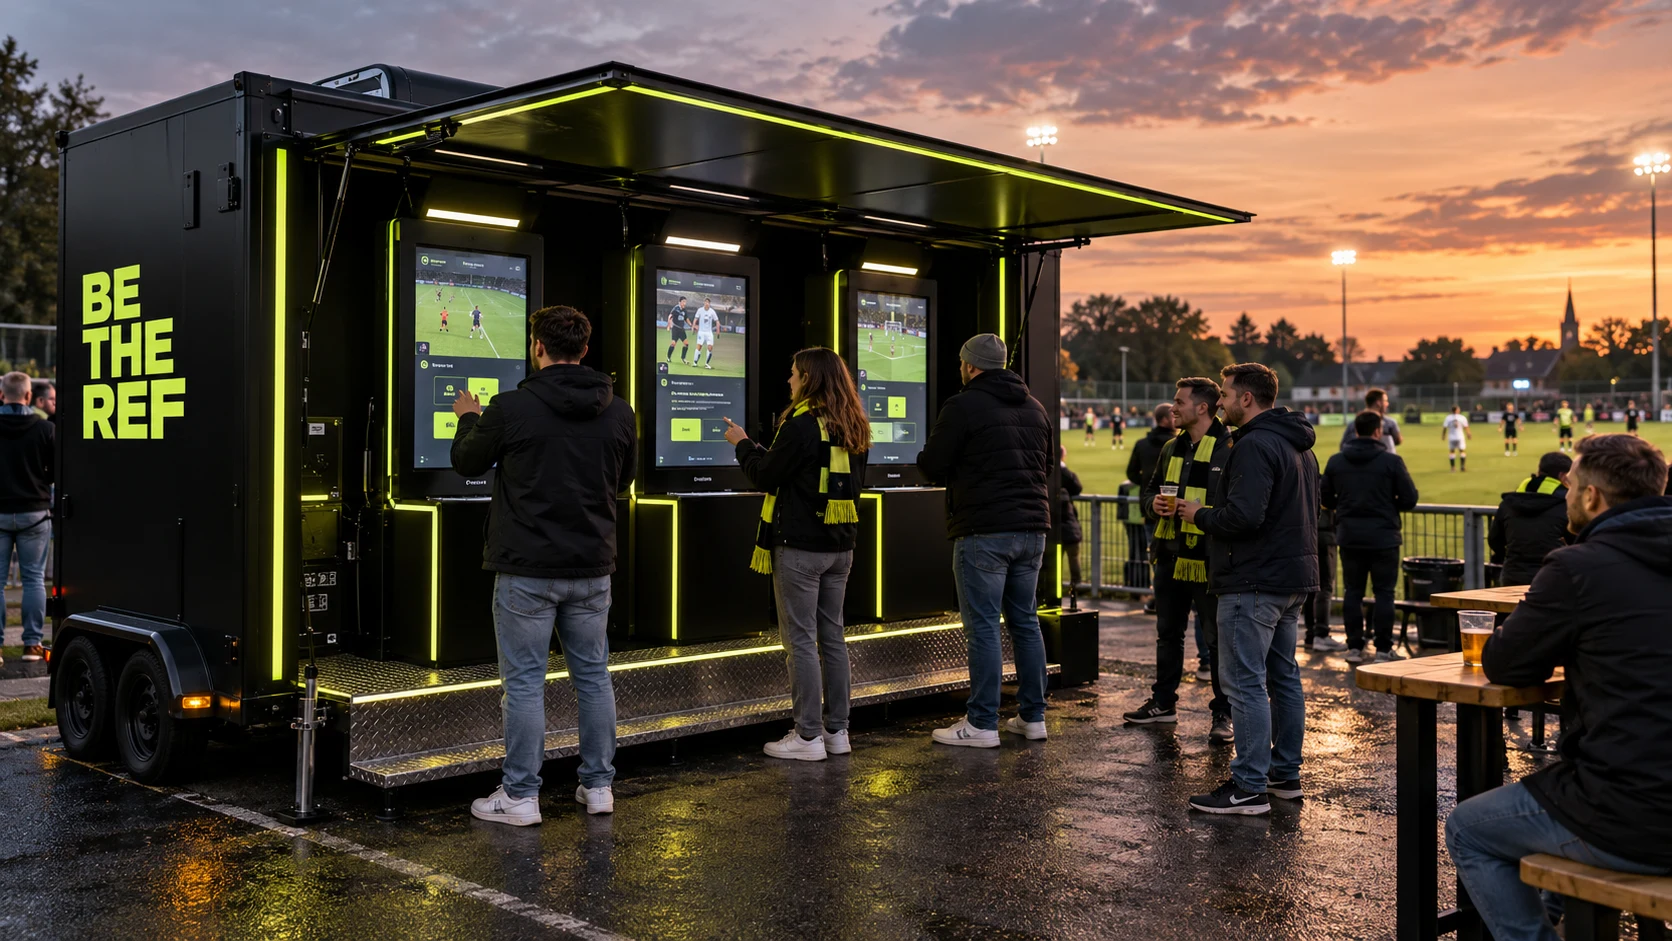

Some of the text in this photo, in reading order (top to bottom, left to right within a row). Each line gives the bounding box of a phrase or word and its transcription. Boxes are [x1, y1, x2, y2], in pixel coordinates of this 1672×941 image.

[82, 264, 141, 325] BE
[82, 317, 174, 380] THE
[82, 377, 186, 440] REF
